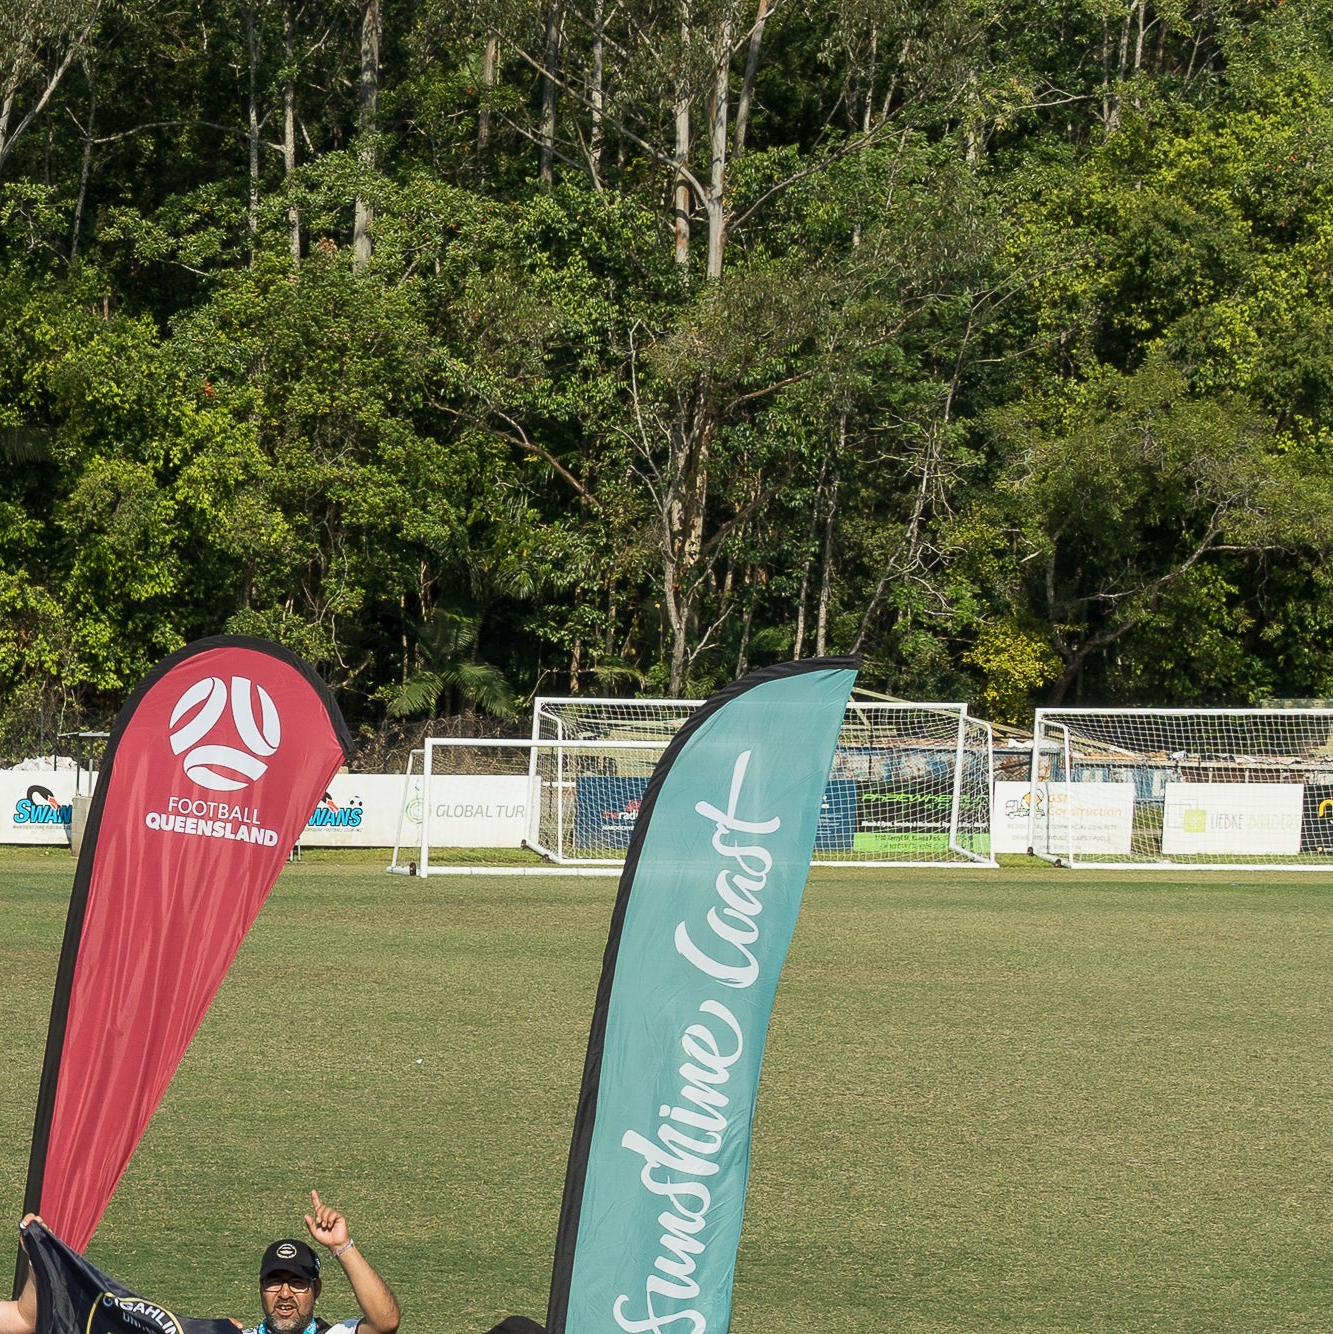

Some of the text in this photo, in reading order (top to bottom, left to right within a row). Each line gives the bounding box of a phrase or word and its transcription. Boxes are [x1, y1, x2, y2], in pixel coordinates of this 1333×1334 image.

[13, 798, 73, 824] SWAN
[168, 796, 261, 825] FOOTBALL
[308, 808, 363, 827] WANS
[145, 812, 279, 847] QUEENSLAND
[675, 750, 781, 988] Coast
